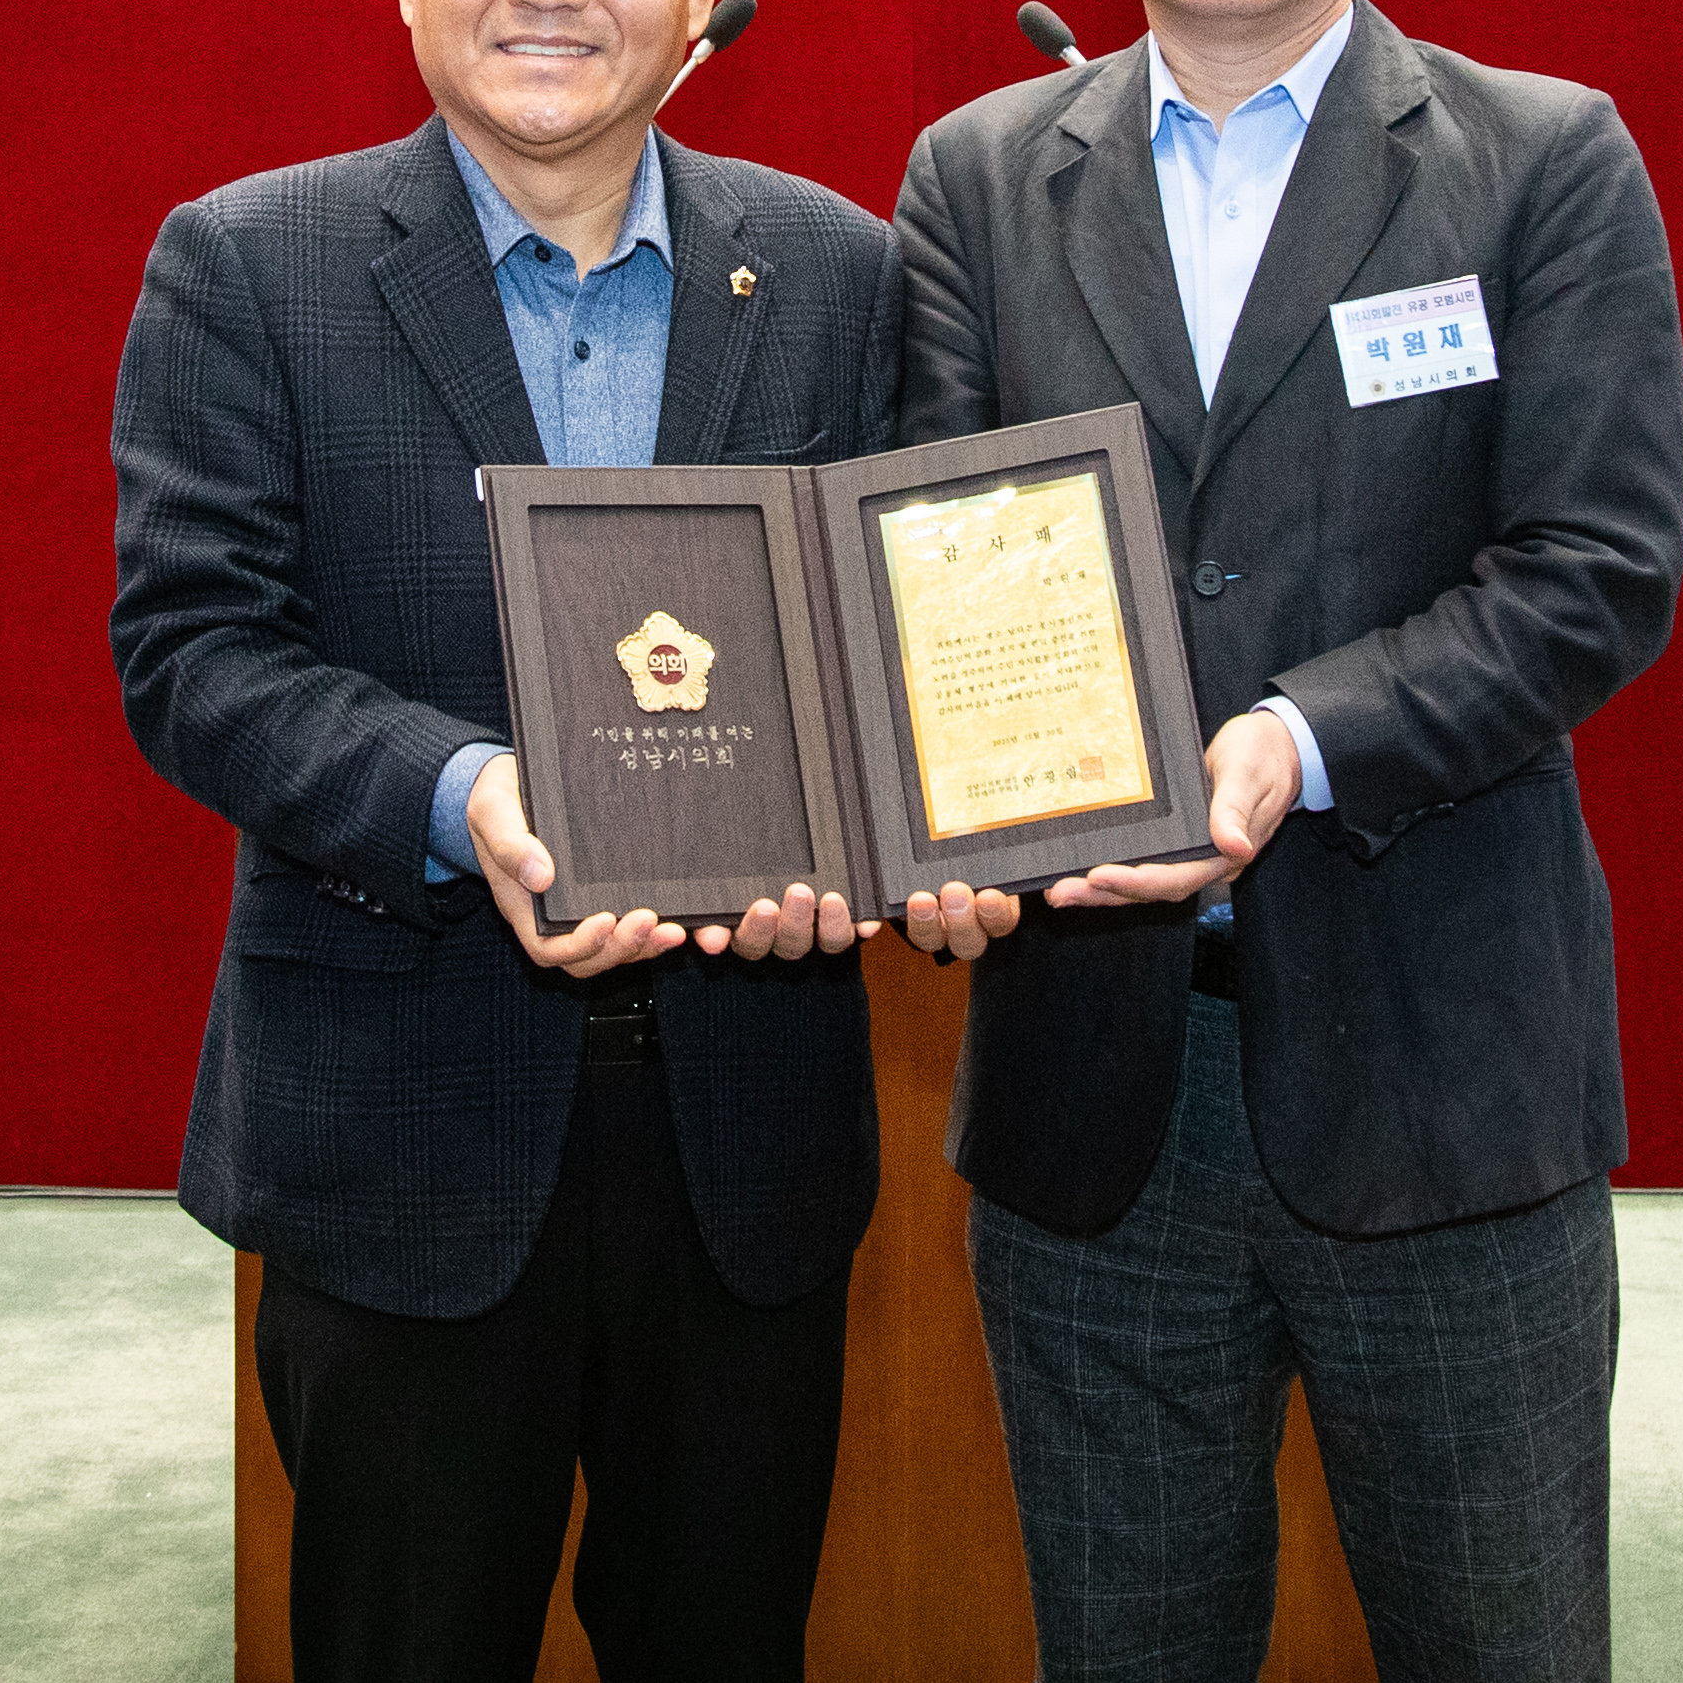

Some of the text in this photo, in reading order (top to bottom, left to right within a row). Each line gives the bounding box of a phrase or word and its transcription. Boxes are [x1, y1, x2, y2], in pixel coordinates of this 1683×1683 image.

[1407, 299, 1429, 313] 유공
[1433, 289, 1476, 307] 모범시민
[648, 653, 686, 676] 의회
[619, 745, 735, 771] 성남시의회
